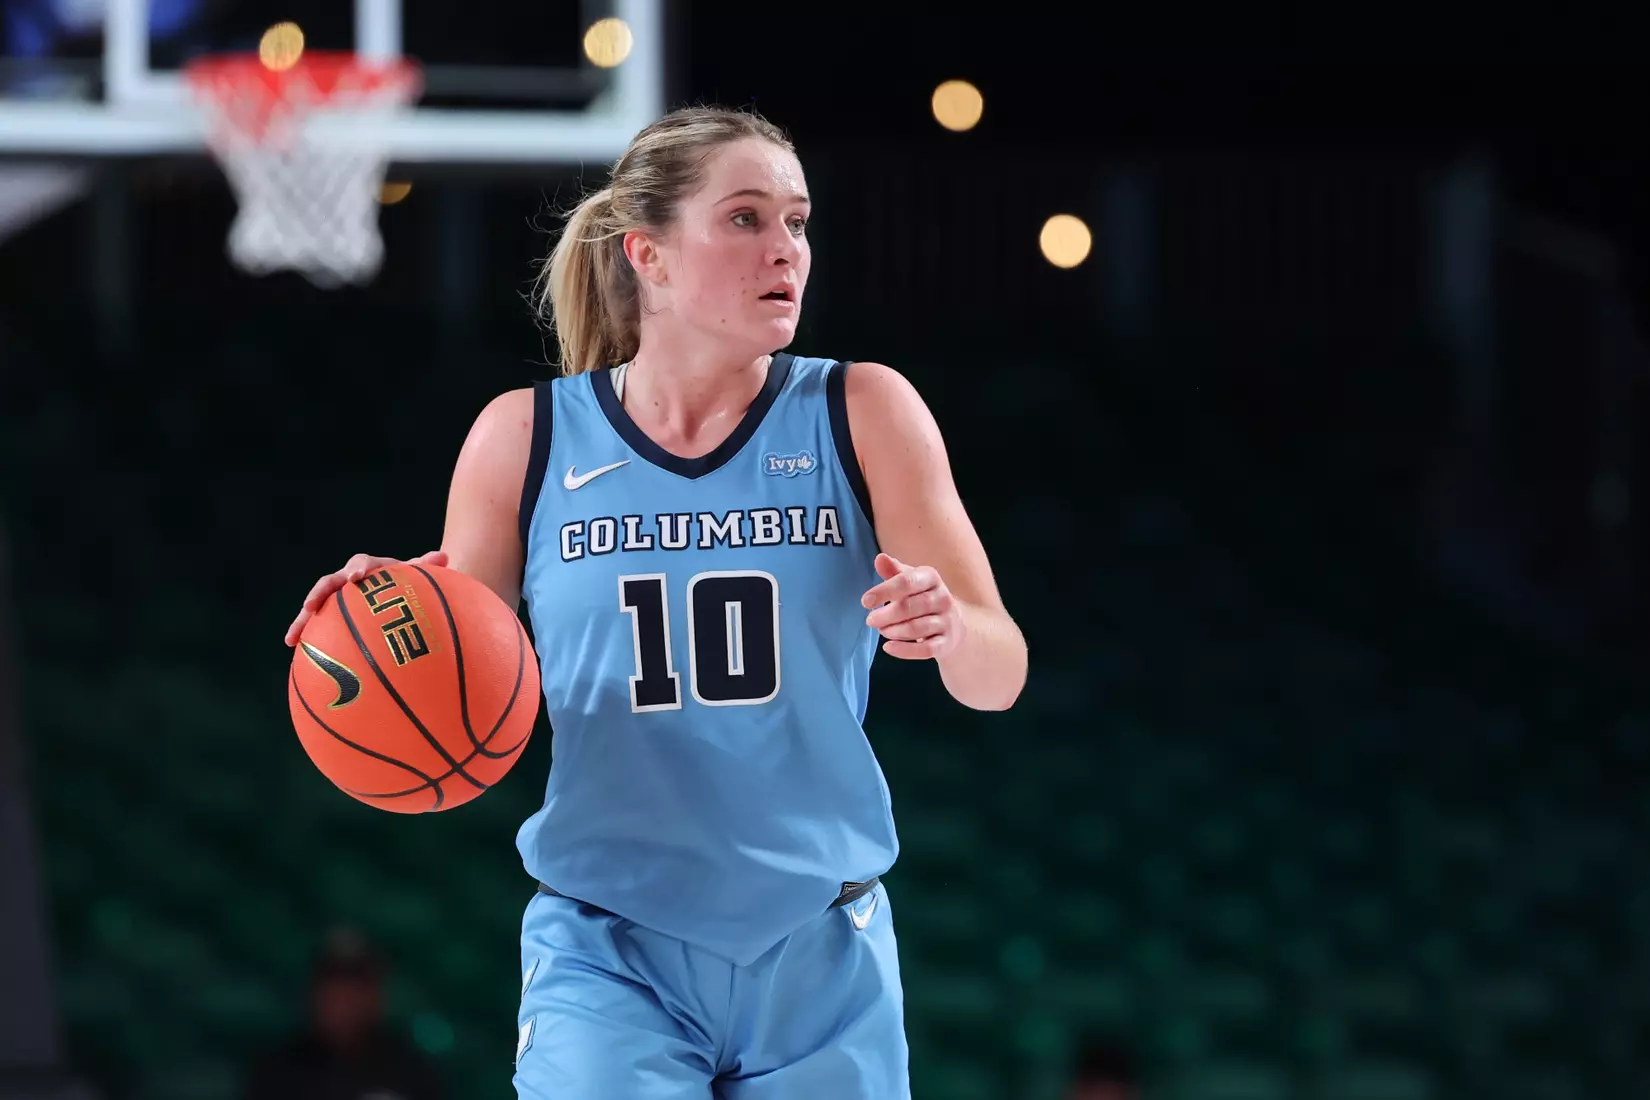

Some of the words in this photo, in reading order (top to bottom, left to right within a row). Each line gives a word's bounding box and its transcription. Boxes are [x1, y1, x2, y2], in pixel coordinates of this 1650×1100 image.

[769, 457, 796, 472] Ivy
[560, 506, 844, 563] COLUMBIA
[618, 570, 782, 713] 10
